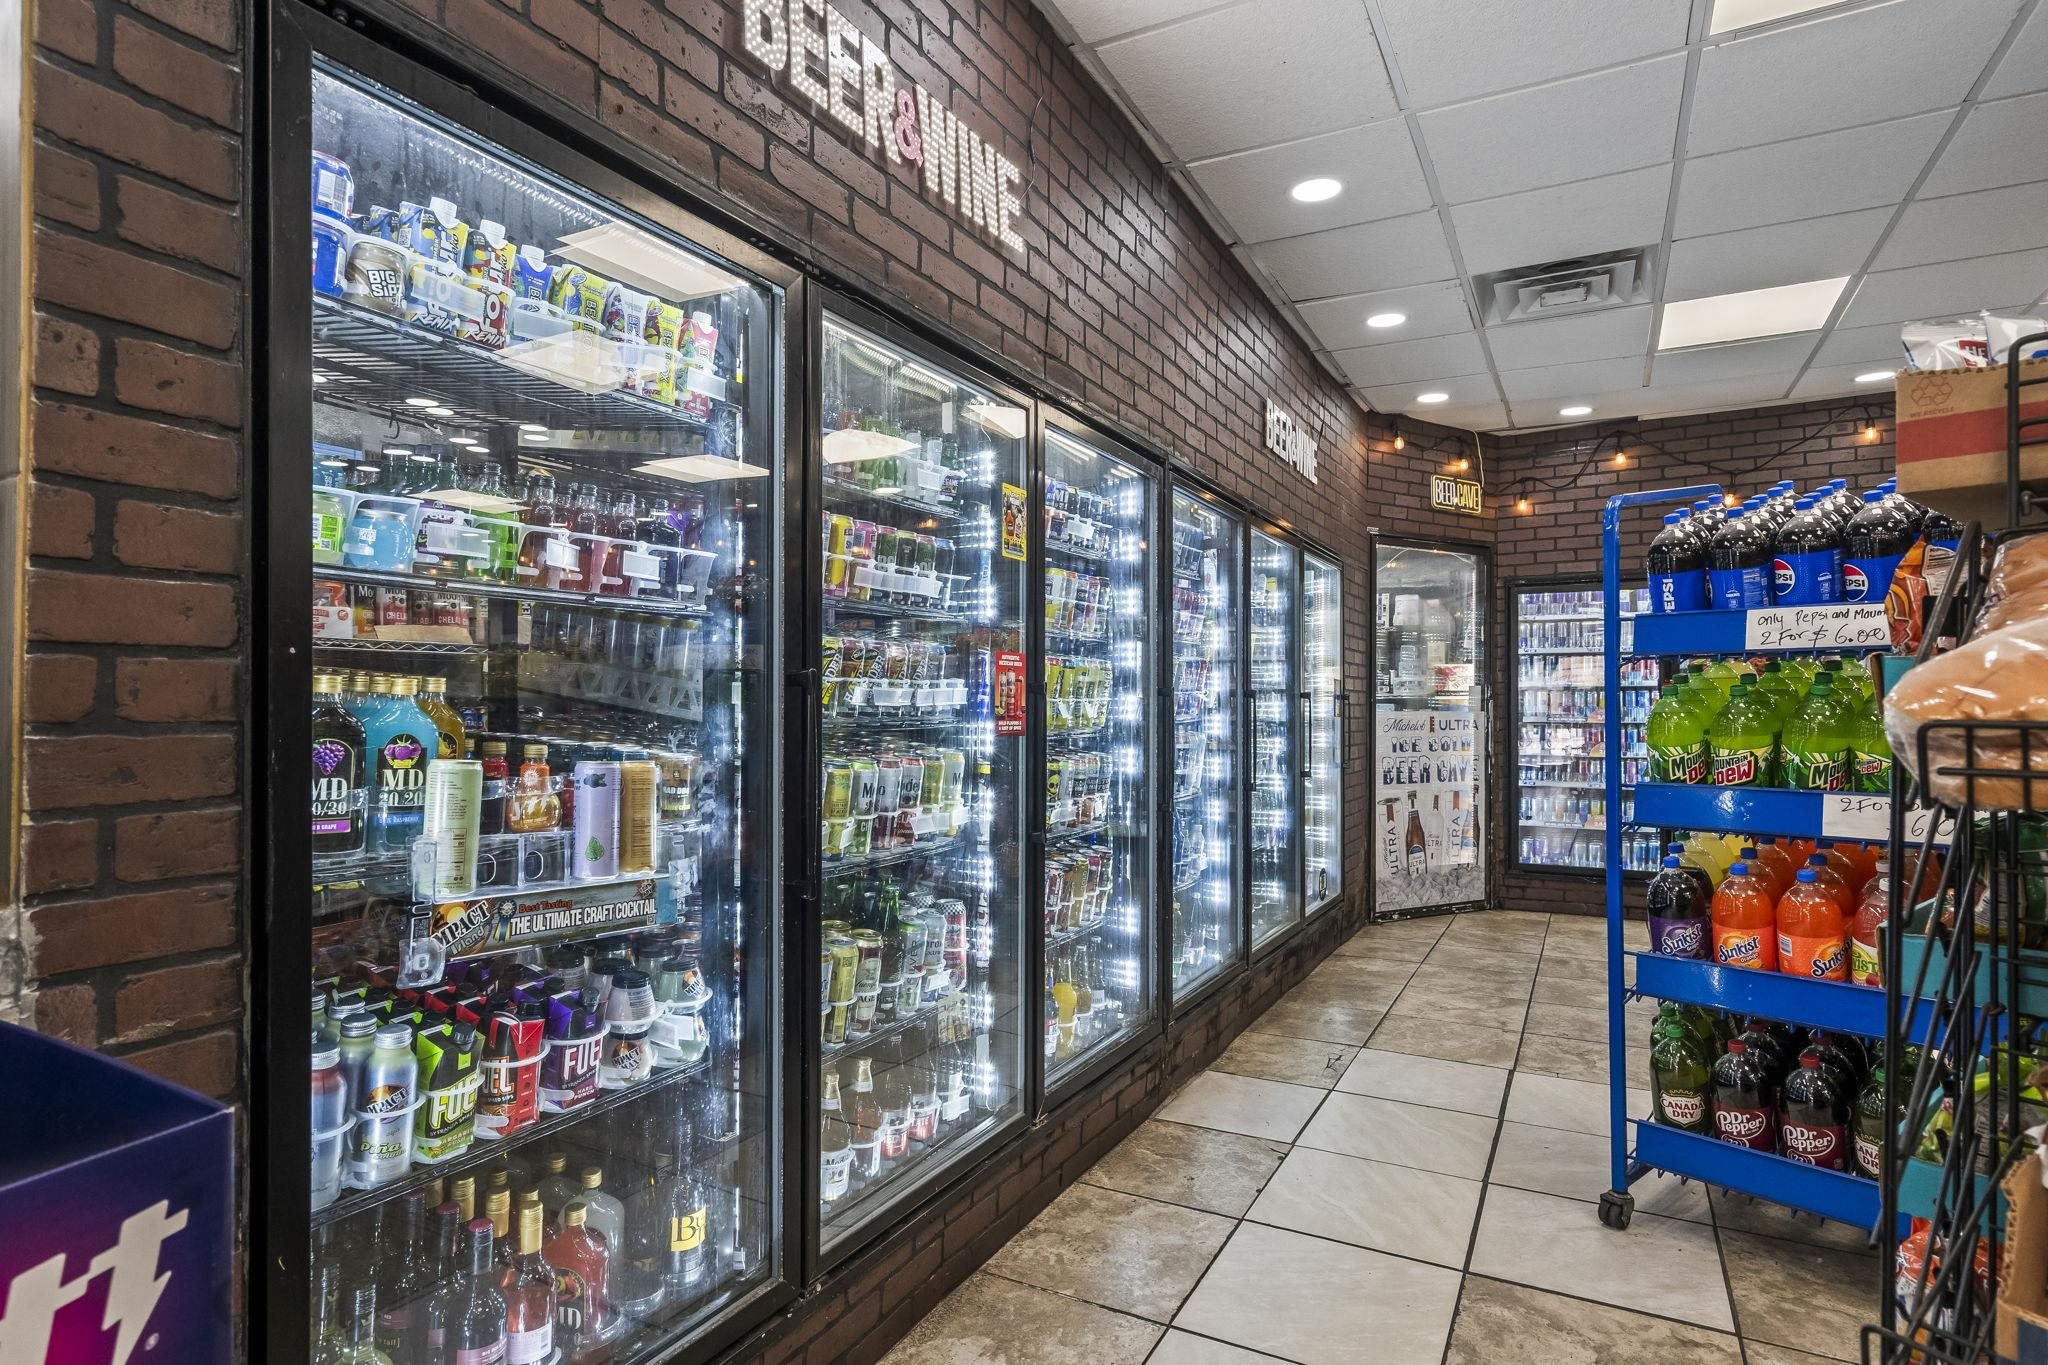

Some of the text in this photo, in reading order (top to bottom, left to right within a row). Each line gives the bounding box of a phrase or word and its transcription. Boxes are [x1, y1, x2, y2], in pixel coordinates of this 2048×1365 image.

[744, 0, 902, 165] BEER
[916, 83, 1025, 254] WINE
[1435, 479, 1479, 510] BEER CAVE
[1775, 573, 1793, 583] EPSI
[1845, 578, 1866, 588] EPSI
[1662, 577, 1676, 612] EPSI
[1757, 613, 1784, 631] only
[1795, 608, 1828, 626] Pepsi
[1832, 608, 1850, 619] and
[1760, 630, 1778, 646] 2
[1778, 628, 1810, 646] For
[1439, 719, 1480, 731] ULTRA
[1390, 735, 1472, 753] ICE COLD
[1382, 754, 1431, 785] BEER
[383, 769, 424, 791] MD
[312, 801, 347, 816] 0/20
[1840, 797, 1855, 812] 2
[1387, 826, 1399, 875] ULTRA
[540, 899, 574, 910] Tasting
[510, 898, 658, 936] THE ULTIMATE CRAFT COCKTAIL
[1661, 924, 1702, 955] Sunkist
[1719, 935, 1760, 963] Sunkist
[1661, 1098, 1706, 1110] CANADA
[1672, 1109, 1697, 1119] DRY
[1715, 1110, 1764, 1136] Pepper
[1730, 1111, 1750, 1123] Dr
[1782, 1124, 1832, 1152] Pepper
[1796, 1127, 1818, 1140] Dr
[1862, 1155, 1879, 1169] DR
